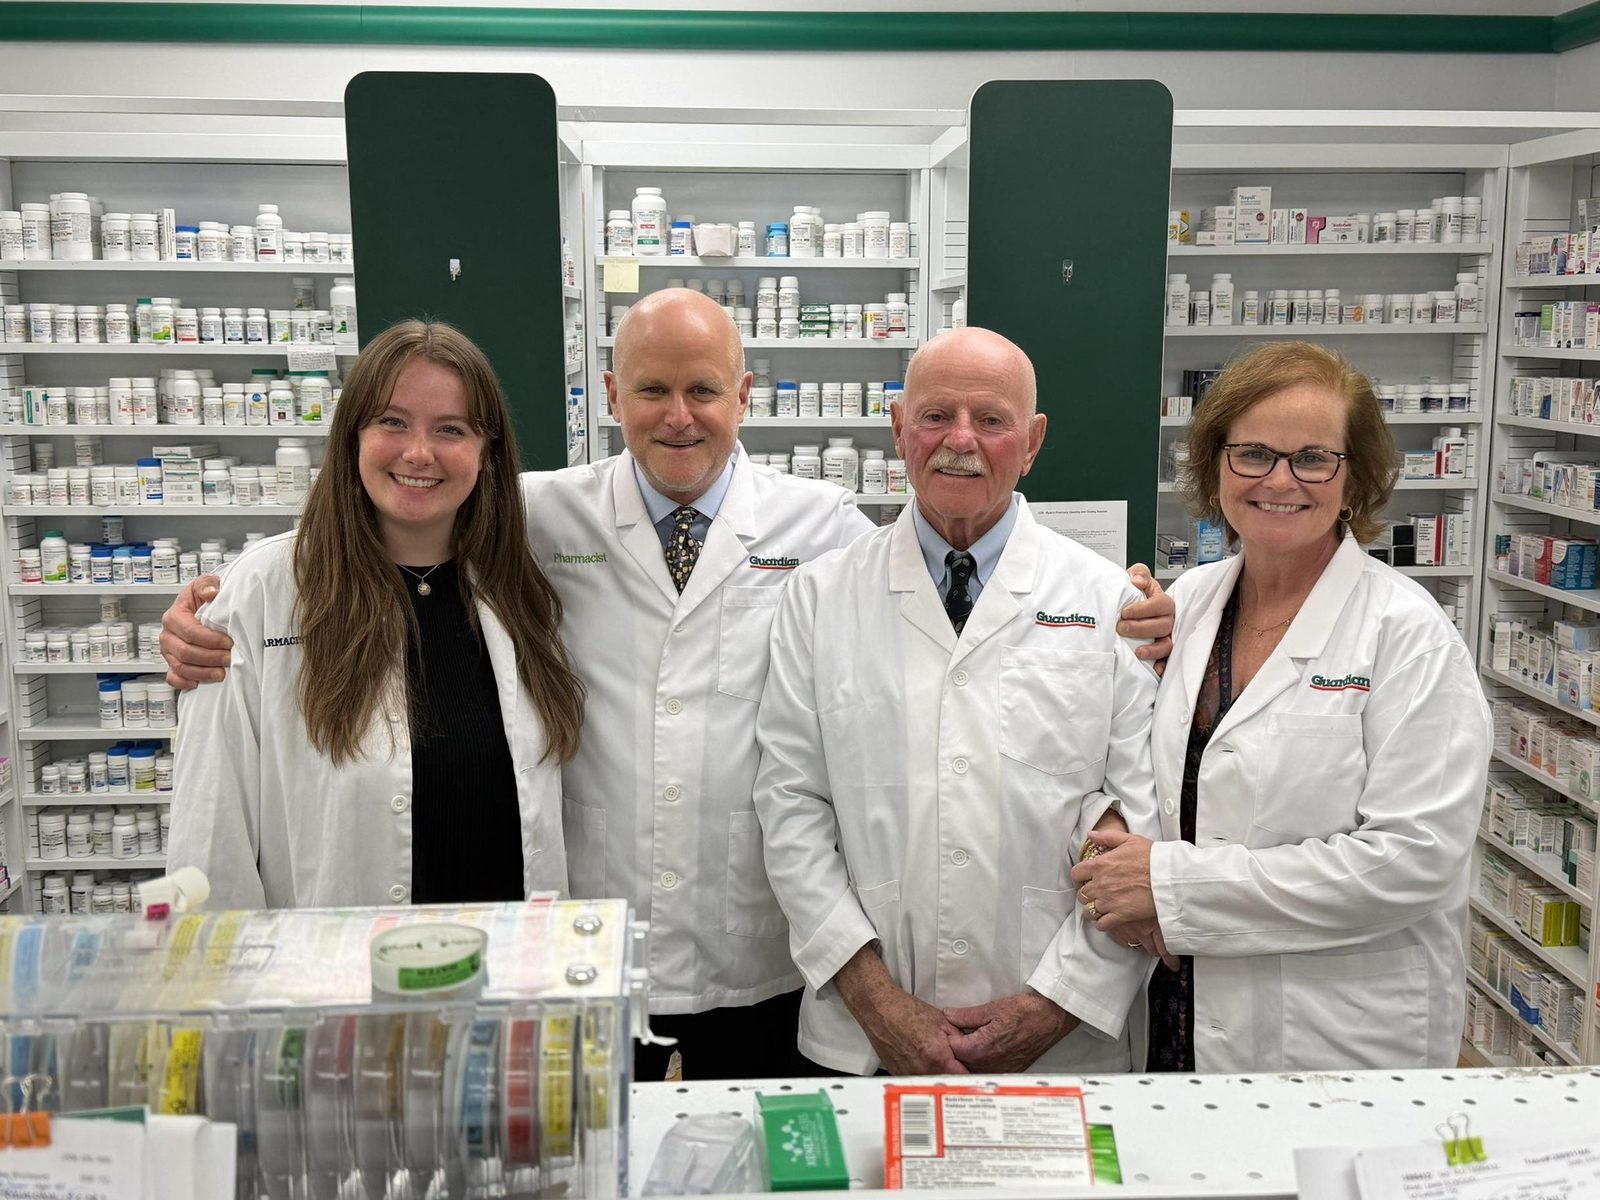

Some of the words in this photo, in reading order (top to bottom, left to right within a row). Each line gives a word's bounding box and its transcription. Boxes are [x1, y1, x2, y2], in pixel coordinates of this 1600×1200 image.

[553, 552, 608, 563] Pharmacist
[750, 556, 799, 566] Guardian
[1036, 611, 1095, 624] Guardian
[1311, 674, 1370, 687] Guardian
